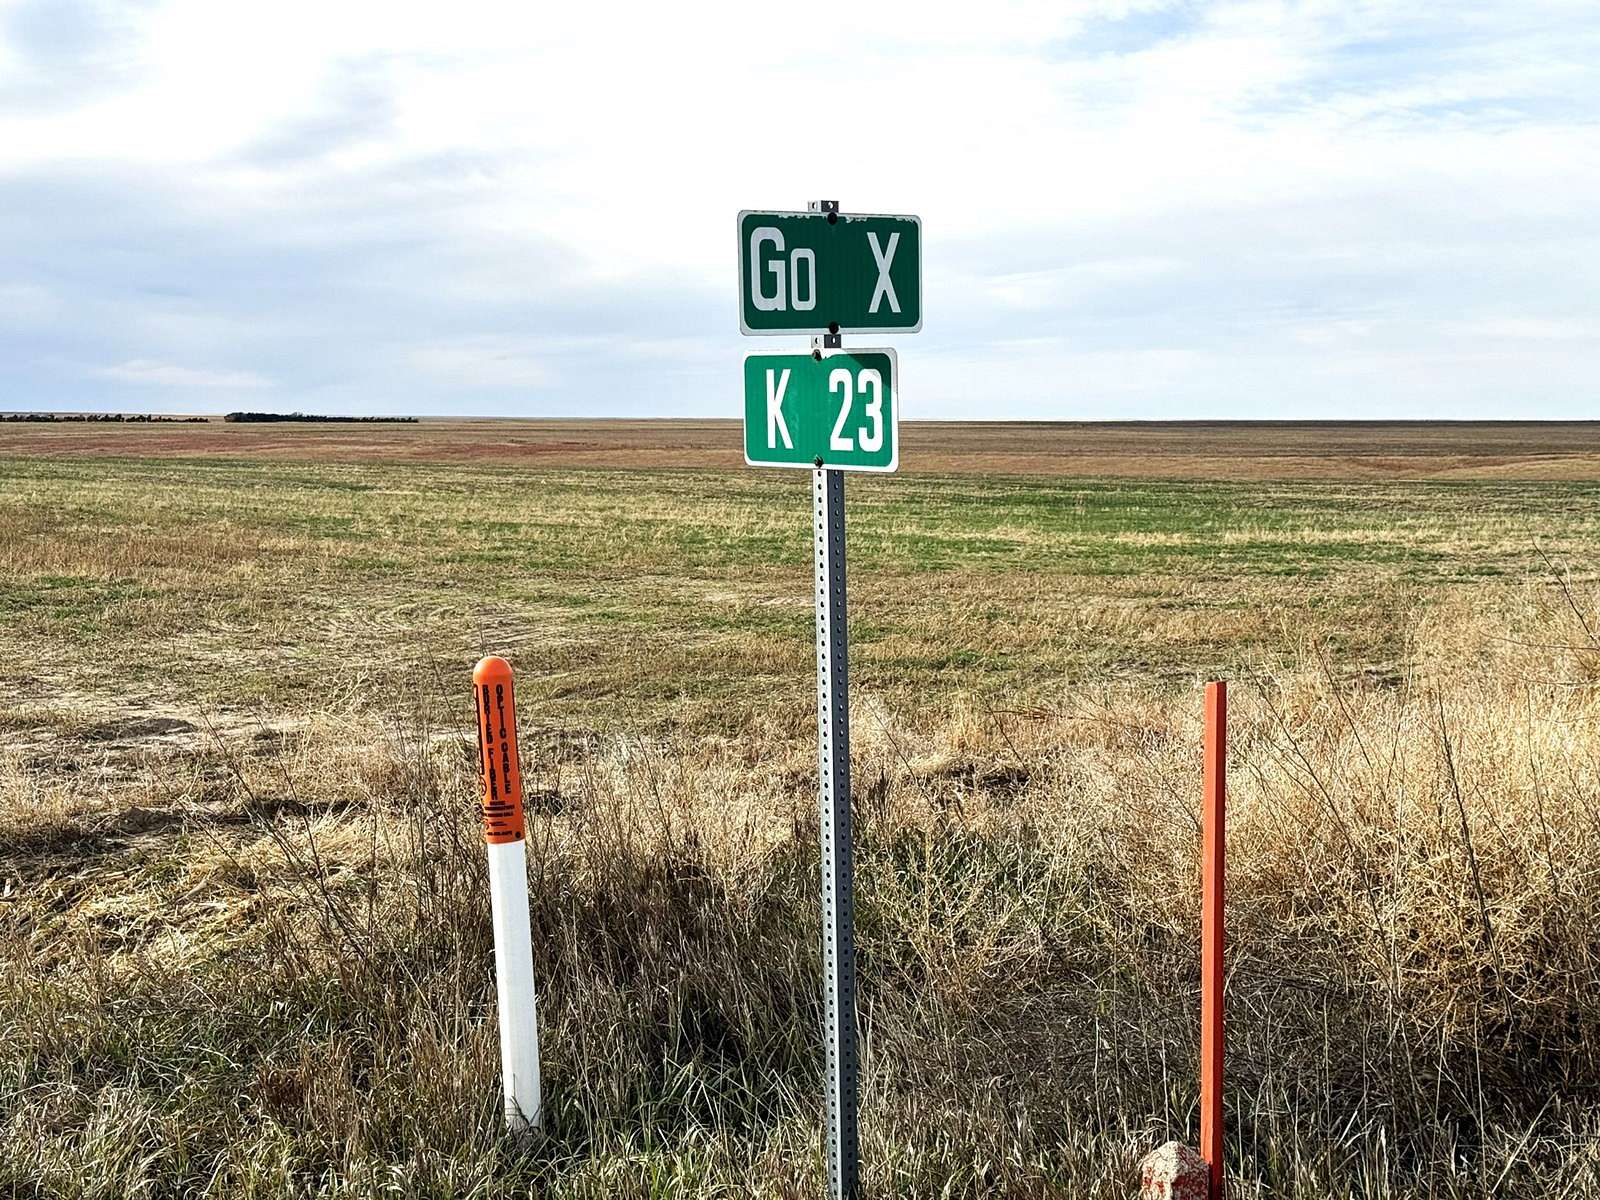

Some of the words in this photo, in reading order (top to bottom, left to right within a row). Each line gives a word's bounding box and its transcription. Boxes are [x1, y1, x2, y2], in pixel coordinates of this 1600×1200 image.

[866, 231, 902, 313] X
[765, 368, 794, 450] K
[828, 367, 884, 453] 23
[496, 684, 506, 739] OPTIC
[501, 742, 511, 794] CABLE
